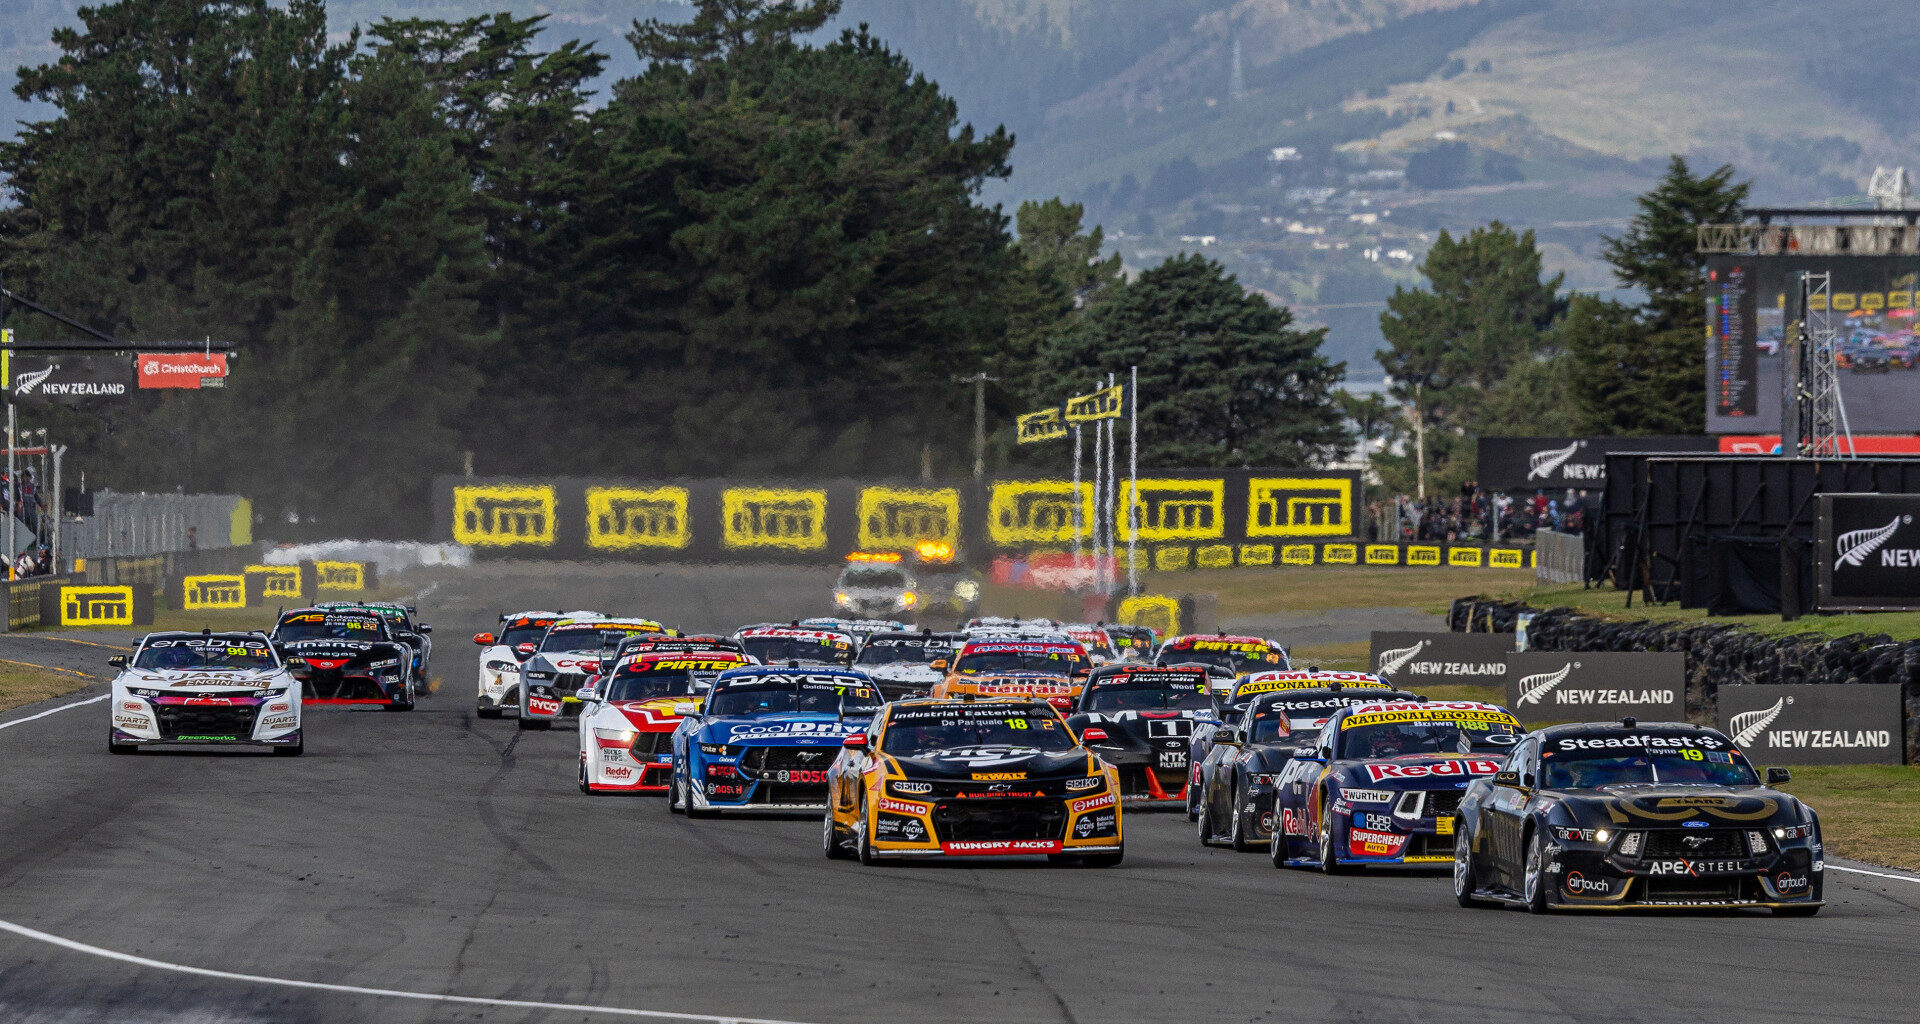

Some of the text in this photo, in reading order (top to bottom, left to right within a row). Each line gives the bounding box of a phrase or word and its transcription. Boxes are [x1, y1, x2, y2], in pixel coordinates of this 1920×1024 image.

[162, 363, 220, 374] Christchurch
[42, 383, 125, 395] NEW ZEALAND
[1563, 464, 1598, 479] NEW
[1252, 483, 1347, 533] itm
[1881, 549, 1920, 567] NEW
[63, 589, 130, 622] itm
[346, 622, 361, 630] 96
[151, 638, 265, 649] erebus
[227, 648, 247, 656] 99
[654, 661, 748, 670] PIRTEK
[1410, 662, 1507, 676] NEW ZEALAND
[141, 672, 275, 681] QUARTZ
[729, 675, 864, 687] DAYCO
[1098, 675, 1129, 684] GR
[1254, 673, 1377, 682] AMPOL
[834, 686, 846, 696] 7
[1242, 680, 1390, 693] NATIONAL SORAG
[1555, 689, 1674, 705] NEW ZEALAND
[529, 698, 559, 712] RYCO
[1357, 702, 1496, 714] AMPOL
[115, 715, 150, 725] QUARTZ
[262, 716, 297, 725] QUARTZ
[894, 710, 959, 719] Industrial
[1347, 711, 1513, 727] NATIONAL STORAGE
[957, 719, 1003, 727] Pasquale
[1004, 718, 1028, 730] 18
[1042, 719, 1054, 731] 2
[1414, 720, 1454, 728] Brown
[1559, 735, 1694, 751] Steadfast
[1768, 730, 1890, 748] NEW ZEALAND
[1160, 751, 1187, 762] NTK
[1645, 748, 1677, 756] Payne
[1678, 749, 1704, 761] 19
[605, 767, 632, 779] Reddy
[1365, 760, 1462, 783] Red
[894, 781, 933, 793] SEIKO
[1065, 777, 1099, 789] SEIKO
[716, 785, 742, 794] BOSCH
[890, 802, 927, 815] HINO
[878, 819, 899, 827] Industrial
[1366, 813, 1391, 824] QUAD
[902, 826, 924, 834] FUCHS
[1075, 822, 1095, 831] FUCHS
[1366, 822, 1392, 832] LOCK
[1352, 830, 1406, 847] SUPERCHEAP
[1558, 830, 1593, 841] GROVE
[949, 841, 1012, 850] HUNGRY
[1366, 844, 1385, 852] AUTO
[1649, 859, 1743, 876] APEX STEEL
[1568, 877, 1609, 892] airtouch
[1778, 874, 1807, 889] airtouch
